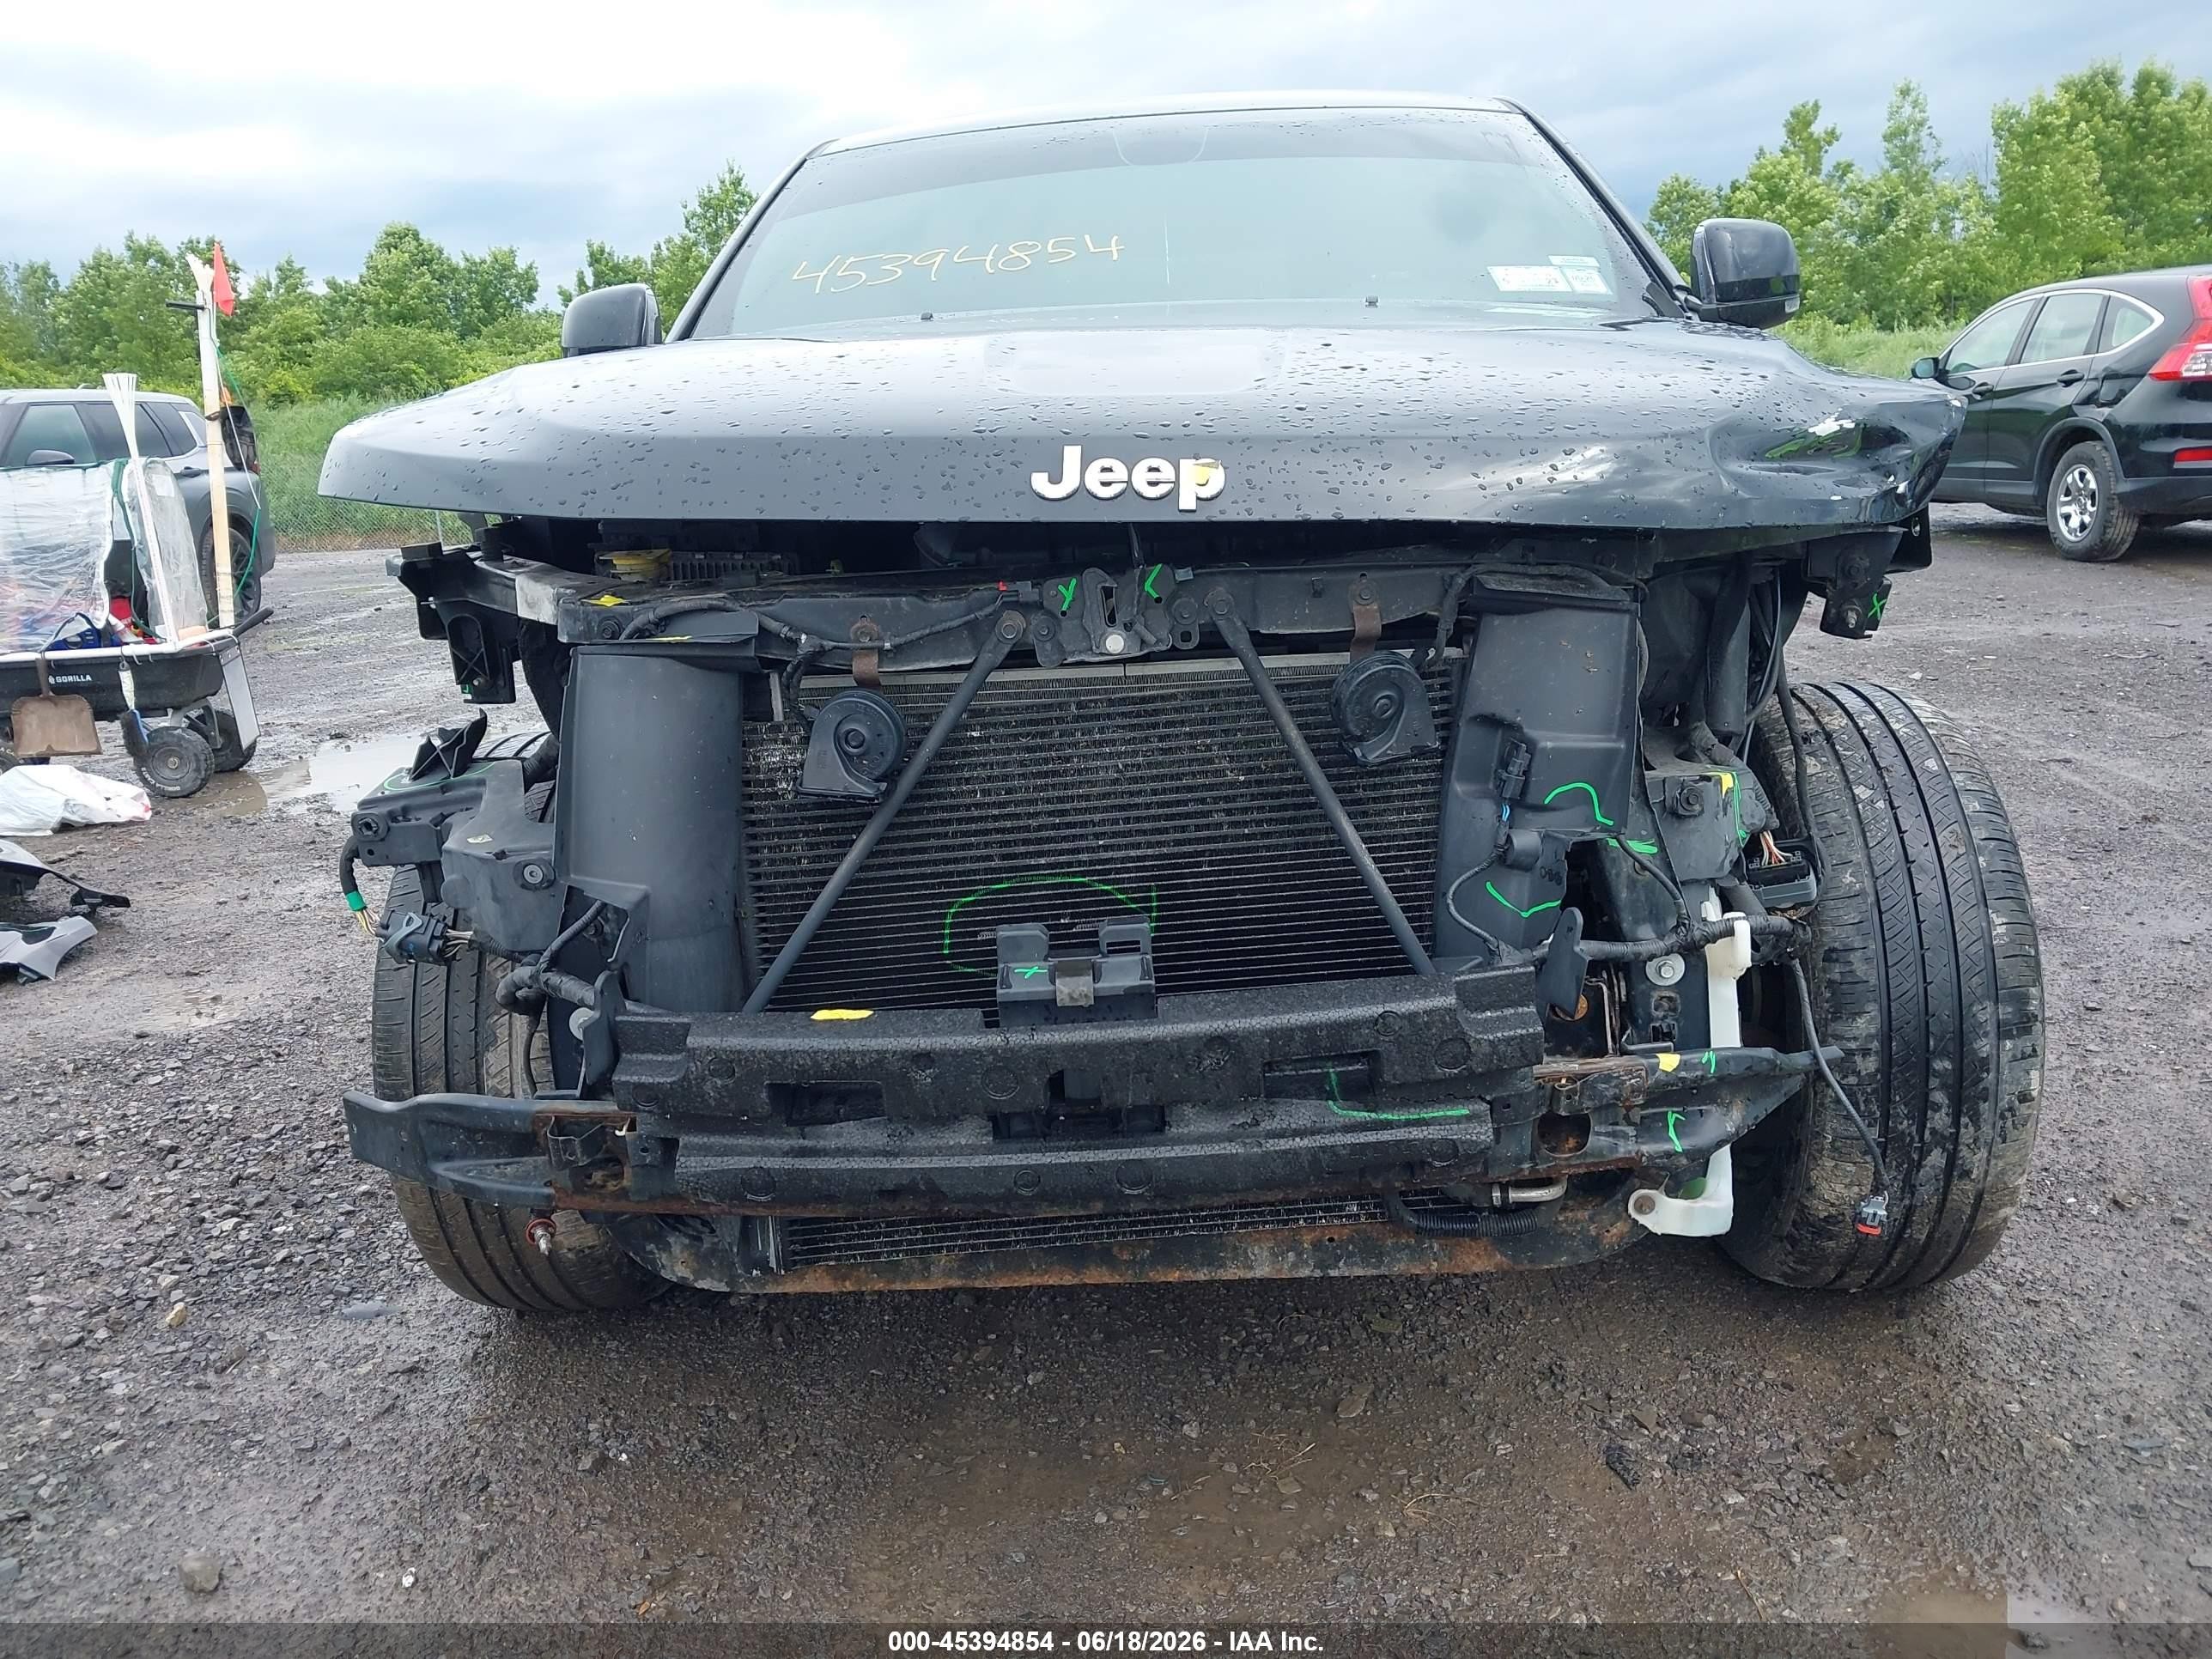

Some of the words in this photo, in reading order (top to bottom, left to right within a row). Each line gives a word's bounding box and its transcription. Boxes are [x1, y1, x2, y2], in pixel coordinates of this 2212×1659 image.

[792, 234, 1125, 295] 45394854
[1030, 445, 1227, 513] Jeep
[55, 673, 93, 684] GORILLA
